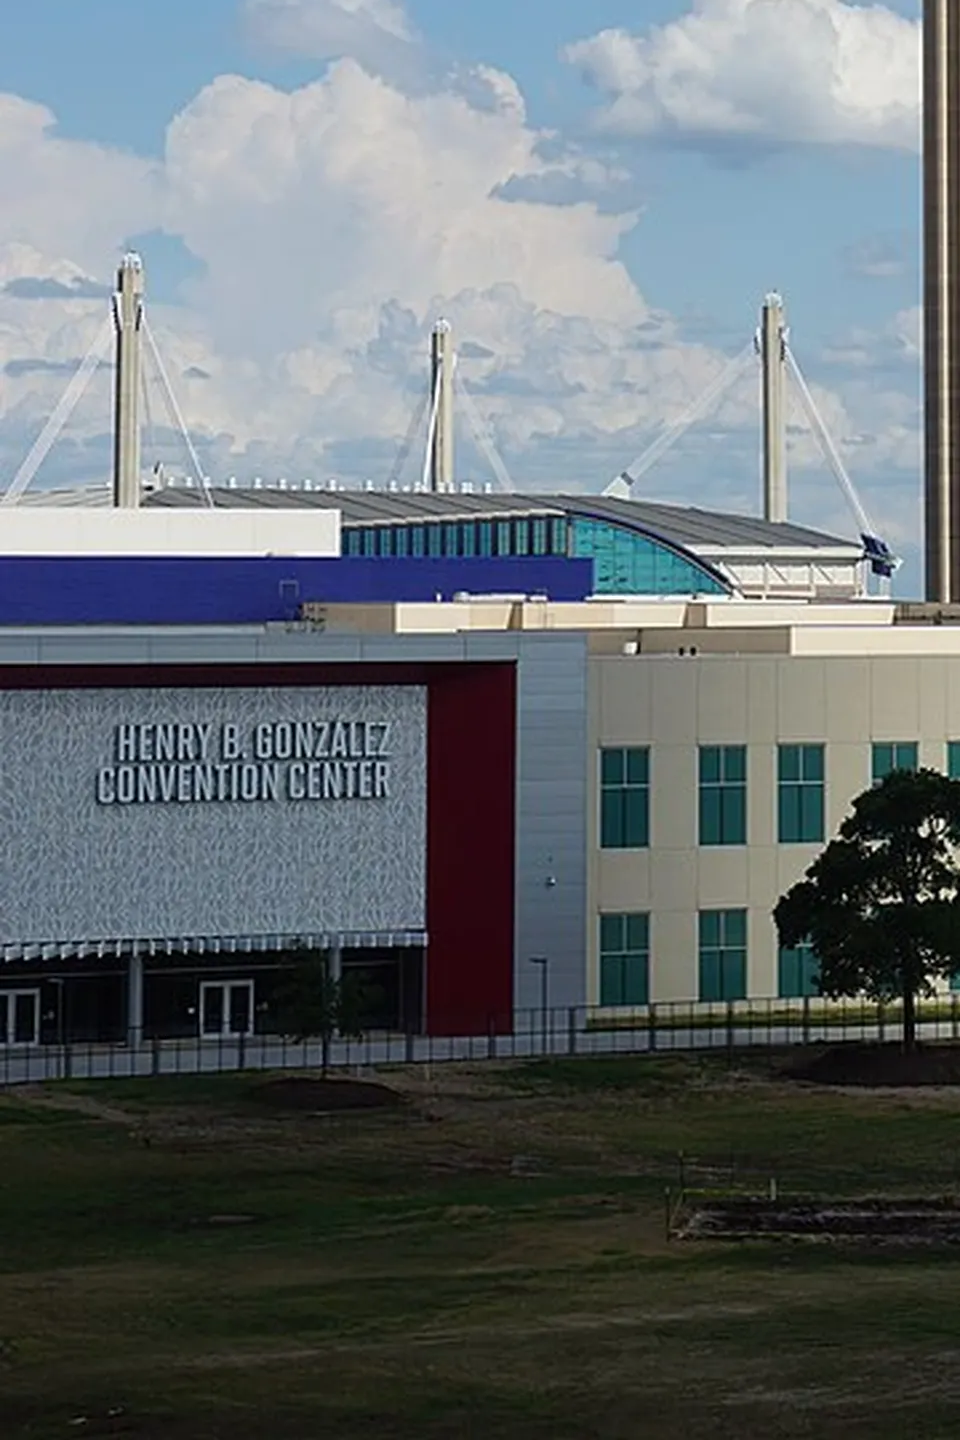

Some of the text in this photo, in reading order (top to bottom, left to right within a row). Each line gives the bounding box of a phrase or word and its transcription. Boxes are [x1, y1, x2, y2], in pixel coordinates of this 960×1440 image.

[116, 724, 211, 761] HENRY
[222, 722, 248, 759] B.
[97, 761, 391, 804] CONVENTION CENTER
